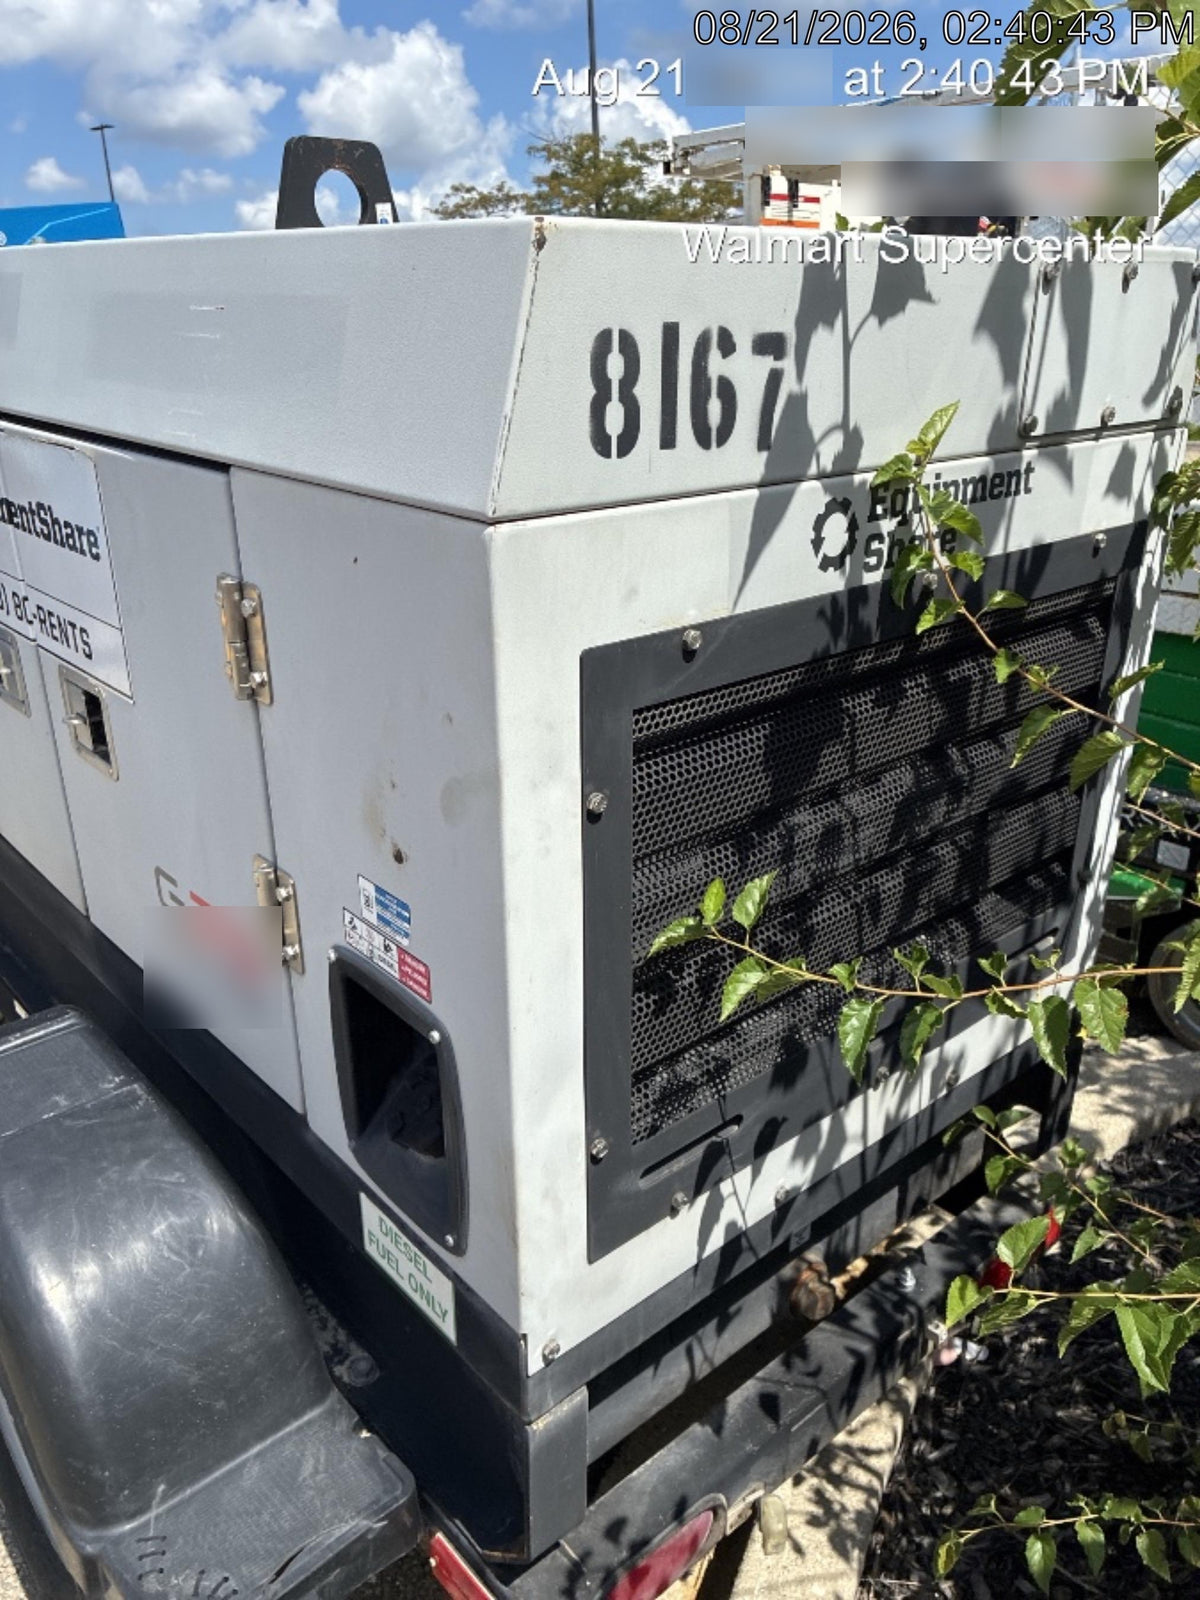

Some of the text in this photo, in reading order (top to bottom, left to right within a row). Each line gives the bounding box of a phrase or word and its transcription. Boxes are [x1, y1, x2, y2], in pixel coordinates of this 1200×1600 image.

[590, 321, 786, 459] 8167
[12, 591, 93, 660] BC-RENTS
[368, 1229, 448, 1323] FUEL ONLY
[379, 1215, 433, 1284] DIESEL
